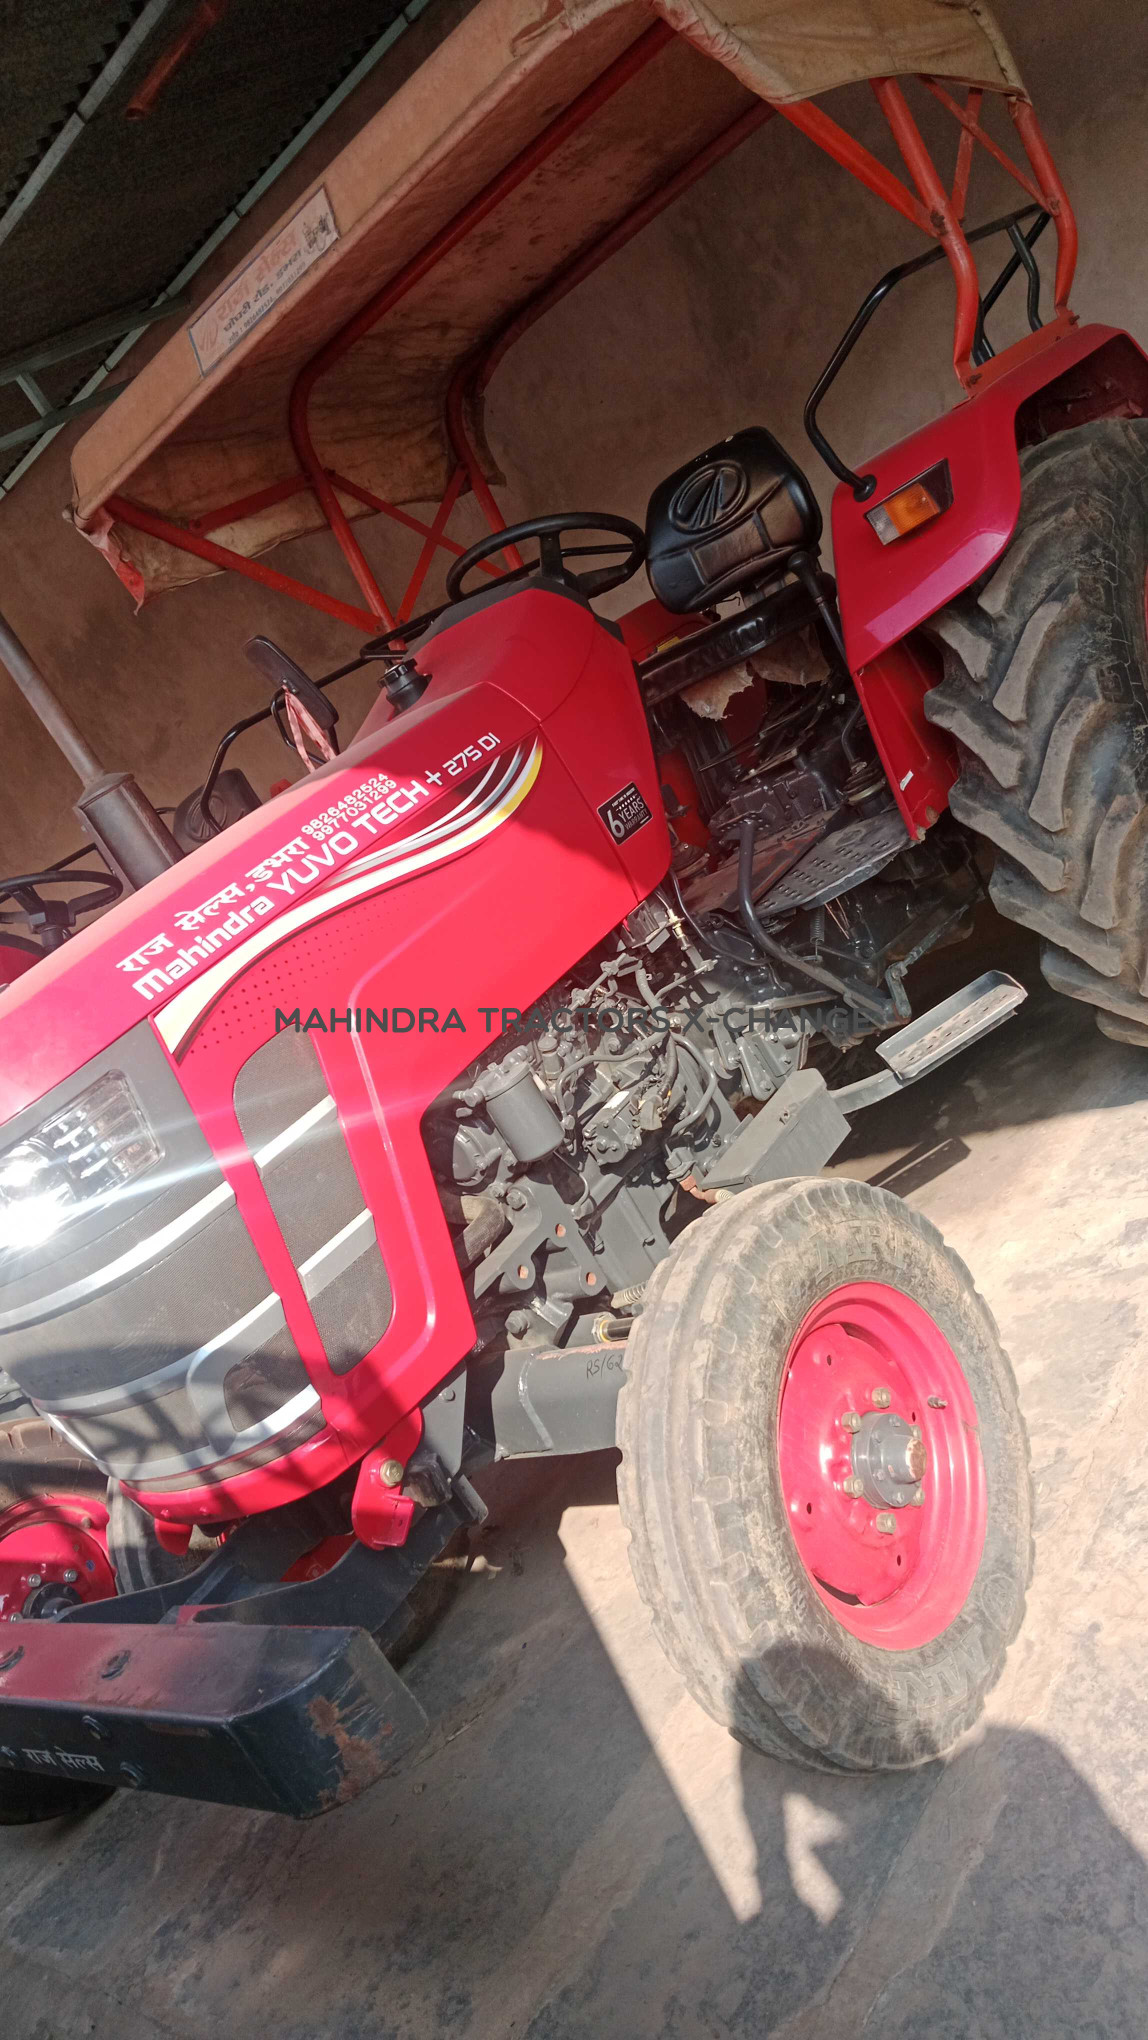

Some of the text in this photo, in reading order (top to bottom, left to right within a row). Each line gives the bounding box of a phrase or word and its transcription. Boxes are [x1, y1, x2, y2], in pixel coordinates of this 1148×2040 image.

[302, 772, 389, 836] 9826482524
[312, 779, 397, 842] 9977031299
[607, 810, 625, 838] 6
[618, 796, 645, 822] YEARS
[132, 897, 276, 1001] Mahindra
[266, 830, 359, 896] YUVO
[442, 748, 482, 777] 275
[478, 732, 501, 751] DI
[116, 933, 175, 974] राज
[21, 1745, 105, 1772] राज सेल्स
